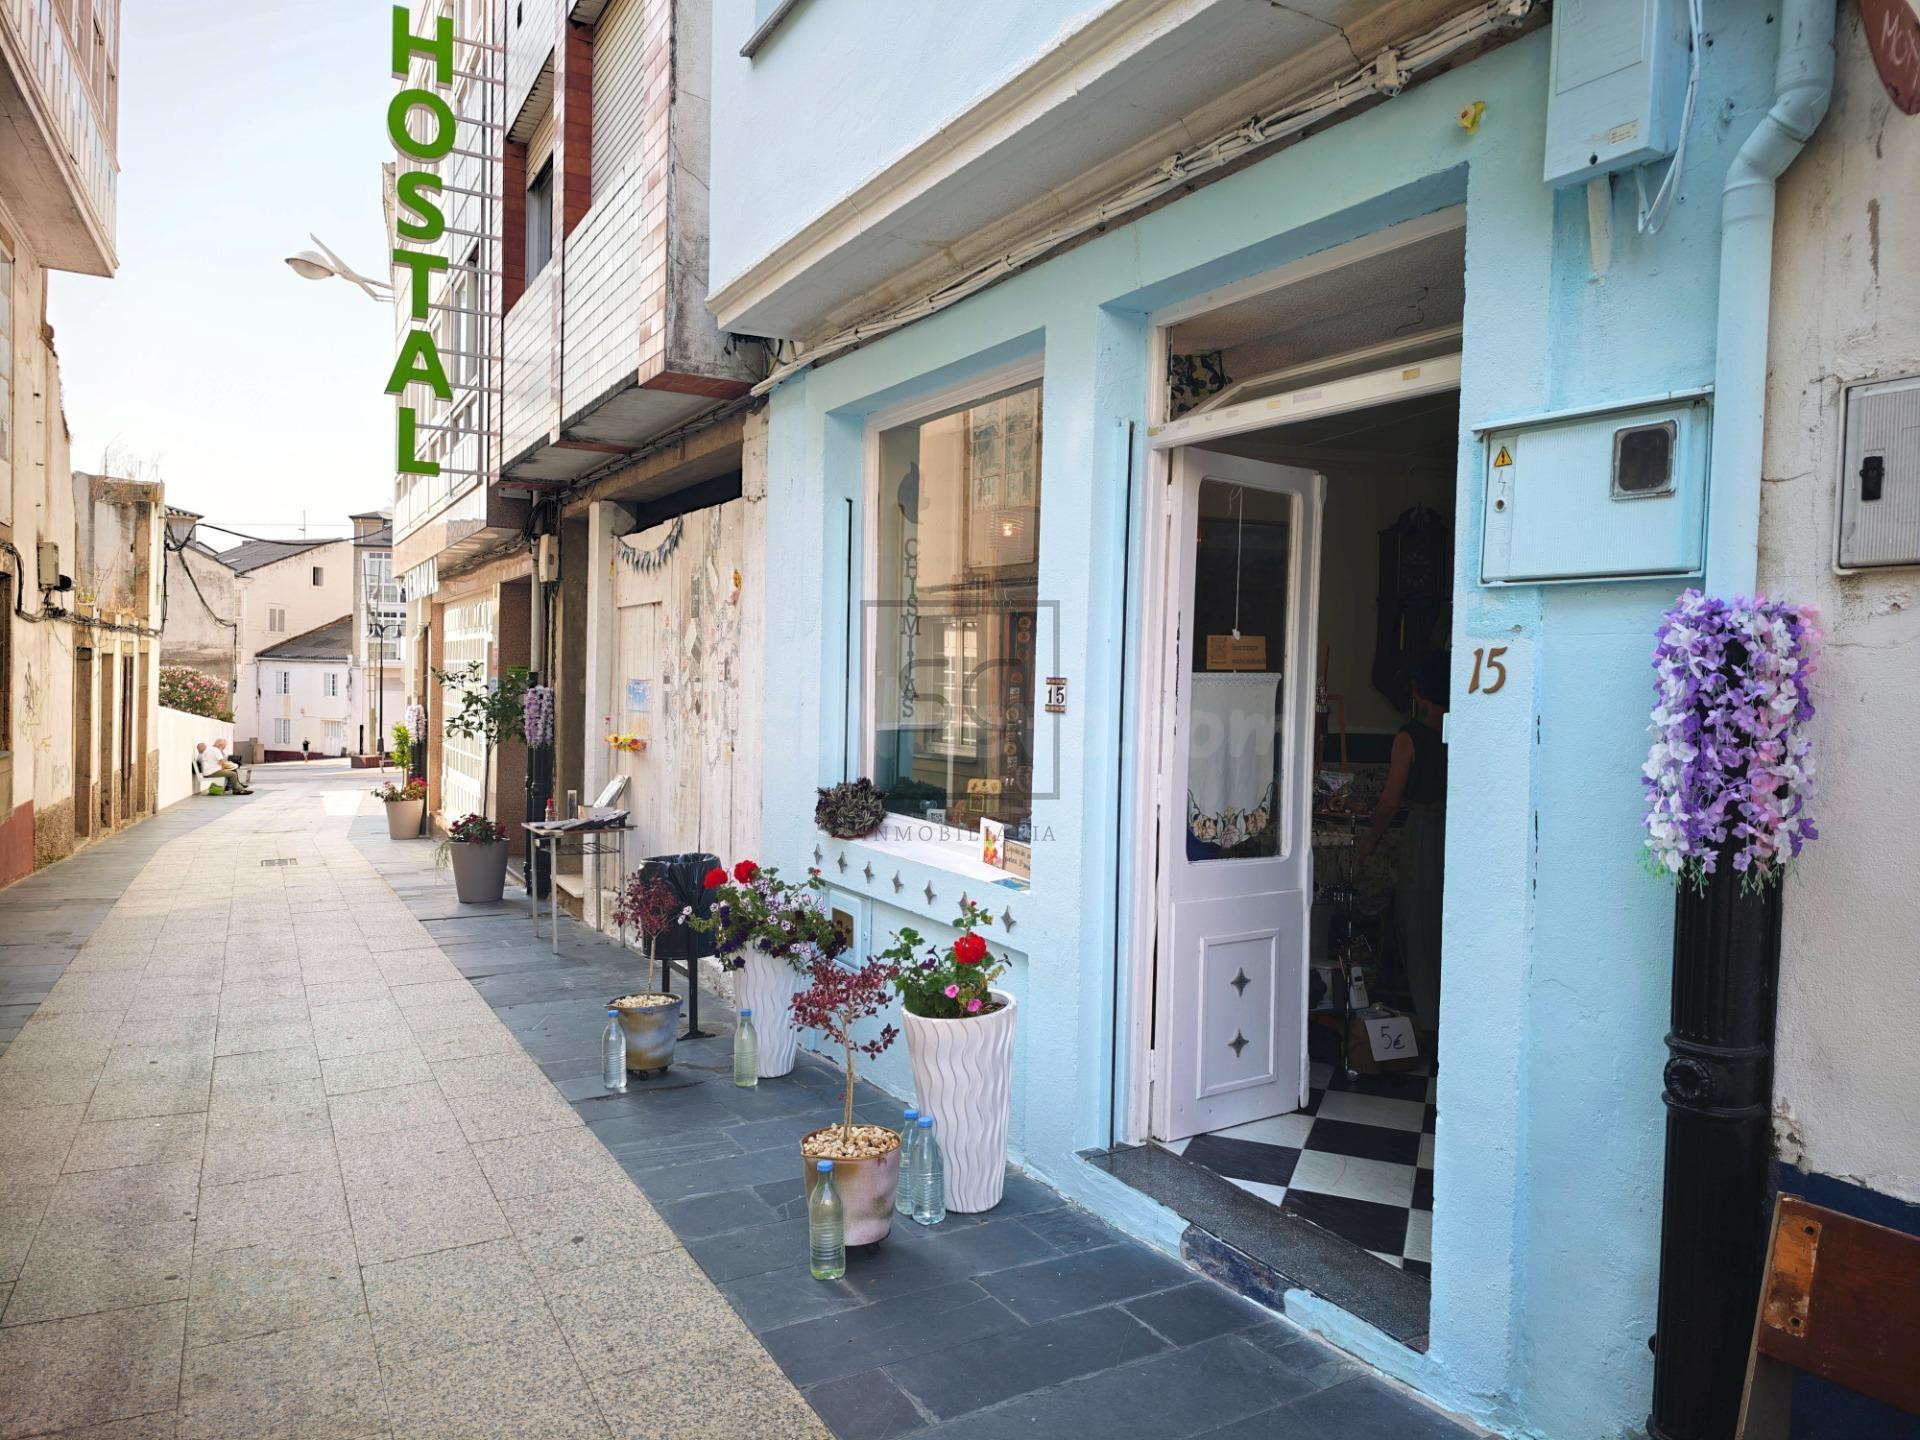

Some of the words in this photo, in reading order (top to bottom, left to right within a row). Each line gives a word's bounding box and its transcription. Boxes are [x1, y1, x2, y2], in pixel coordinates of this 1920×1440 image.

[385, 4, 457, 476] HOSTAL
[1467, 645, 1508, 694] 15
[1047, 686, 1065, 704] 15
[1380, 1025, 1406, 1050] 5€
